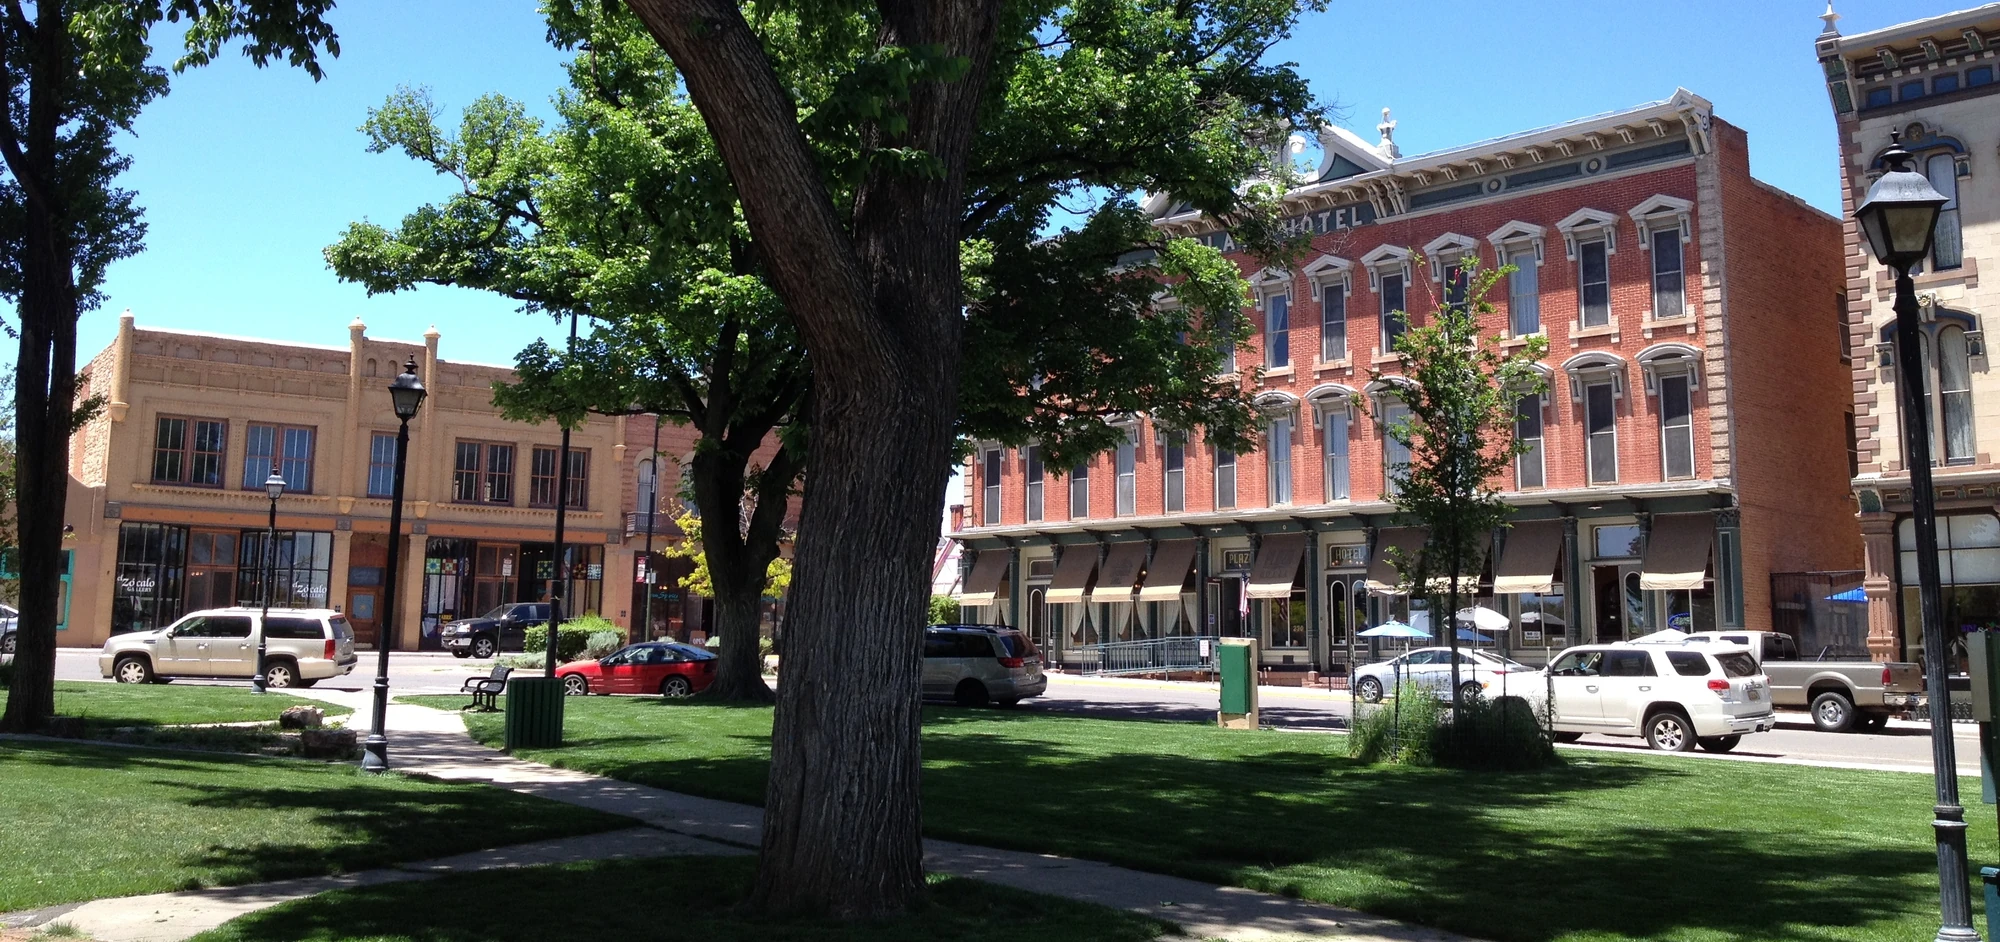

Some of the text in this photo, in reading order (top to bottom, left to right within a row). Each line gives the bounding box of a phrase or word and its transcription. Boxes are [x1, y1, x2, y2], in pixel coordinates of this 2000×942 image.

[1283, 206, 1363, 238] HOTEL
[1229, 553, 1250, 564] PLAZ
[1335, 548, 1364, 560] HOTEL
